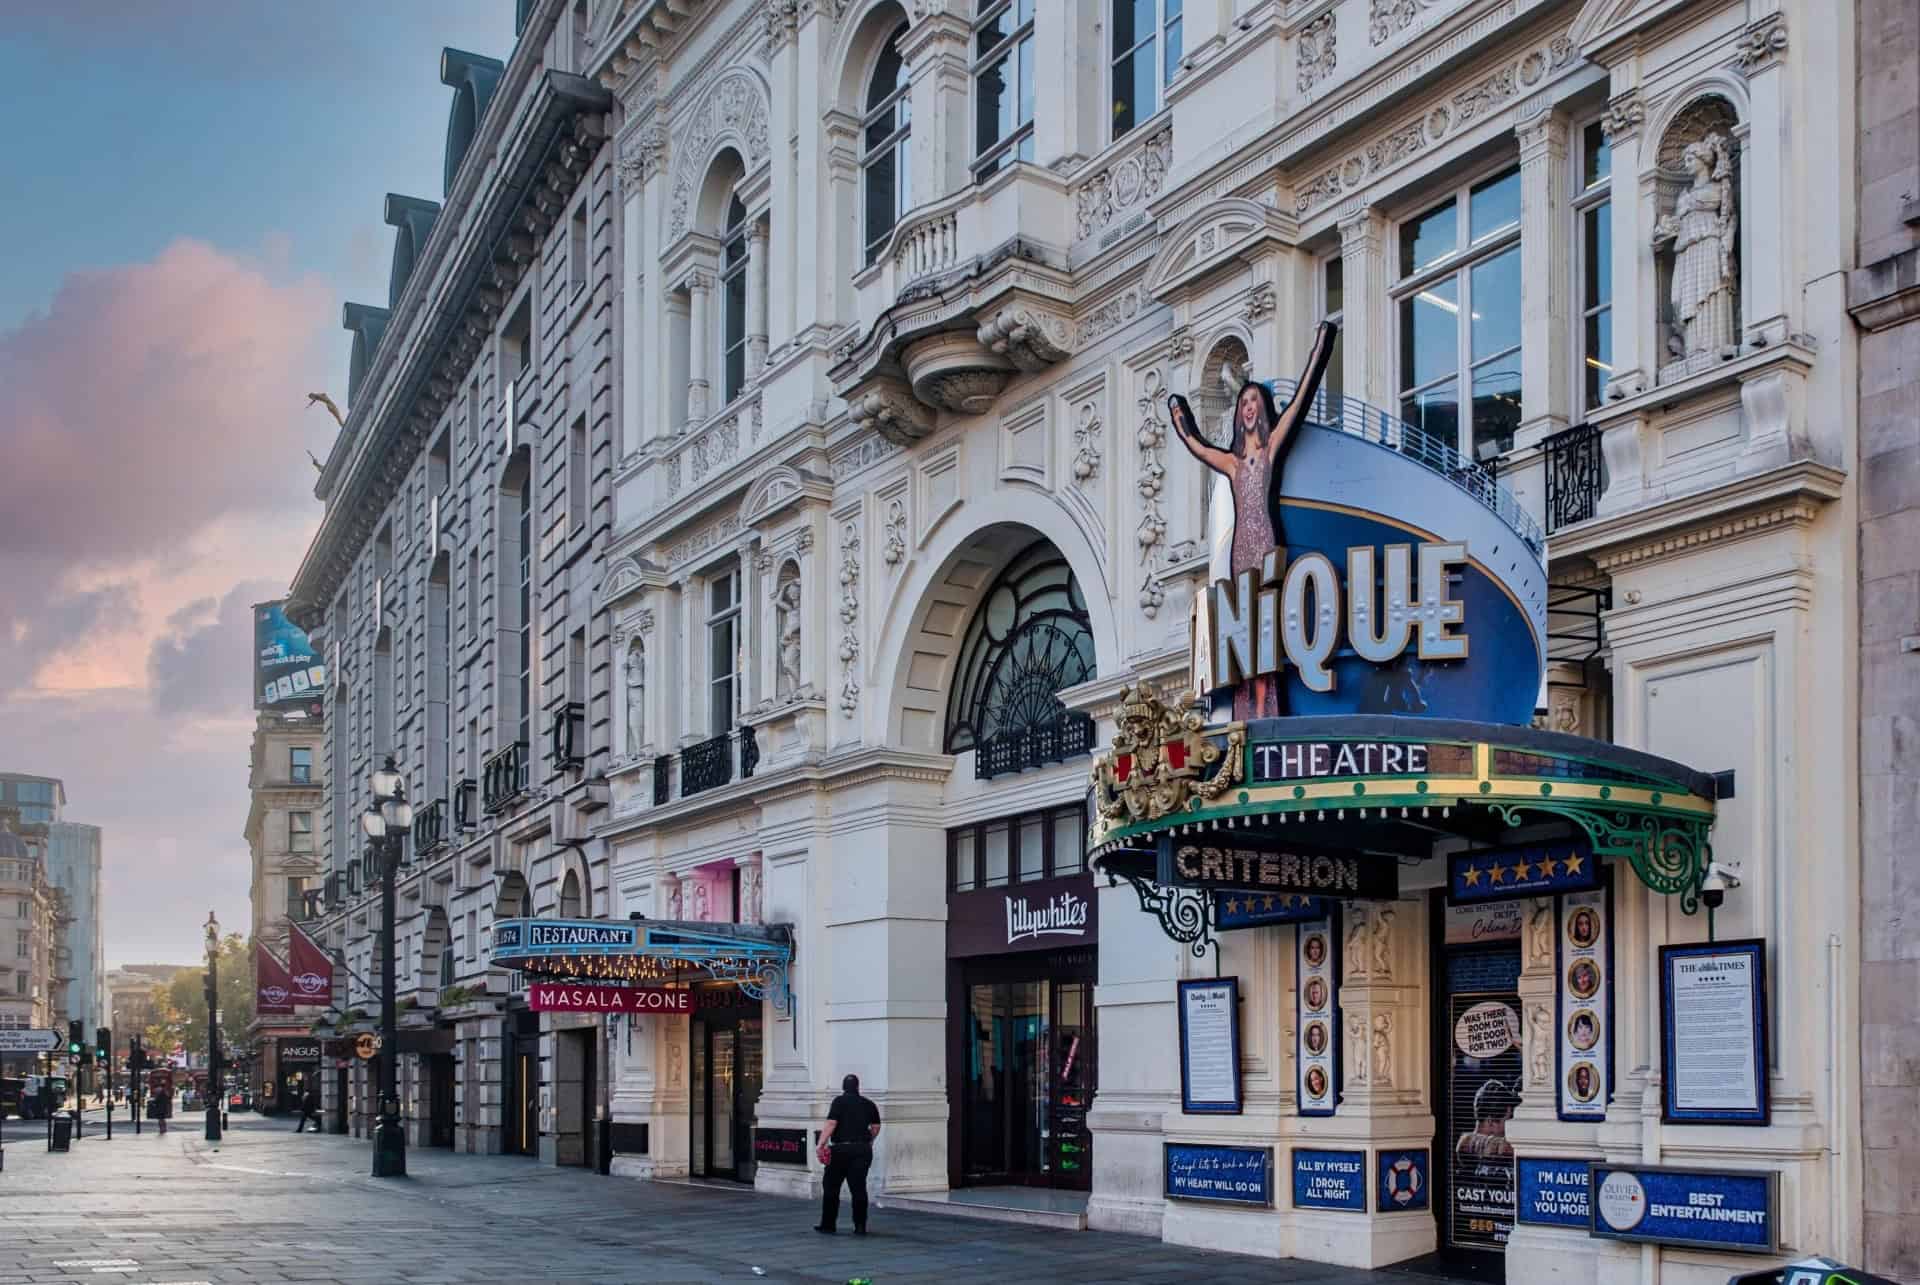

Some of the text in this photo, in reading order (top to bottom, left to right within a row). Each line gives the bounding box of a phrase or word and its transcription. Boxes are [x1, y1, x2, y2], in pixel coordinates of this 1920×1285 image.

[1255, 743, 1428, 778] THEATRE
[1176, 846, 1358, 890] CRITERION
[532, 927, 629, 944] RESTAURANT
[1680, 961, 1745, 973] THE TIMES
[539, 990, 623, 1007] MASALA
[635, 992, 688, 1009] ZONE
[1464, 1013, 1481, 1024] WAS
[1468, 1019, 1504, 1032] ROOM ON
[1468, 1029, 1506, 1042] THE DOOR
[282, 1047, 320, 1056] ANGUS
[1469, 1042, 1485, 1052] FOR
[1297, 1160, 1361, 1173] ALL BY MYSELF
[1316, 1177, 1345, 1189] DROVE
[1538, 1171, 1589, 1185] I'M ALIVE
[1175, 1177, 1261, 1193] MY HEART WILL GO ON
[1306, 1188, 1351, 1200] ALL NIGHT
[1457, 1187, 1486, 1202] CAST
[1539, 1190, 1587, 1204] TO LOVE
[1688, 1192, 1724, 1207] BEST
[1534, 1201, 1557, 1213] YOU
[1650, 1204, 1766, 1224] ENTERTAINMENT
